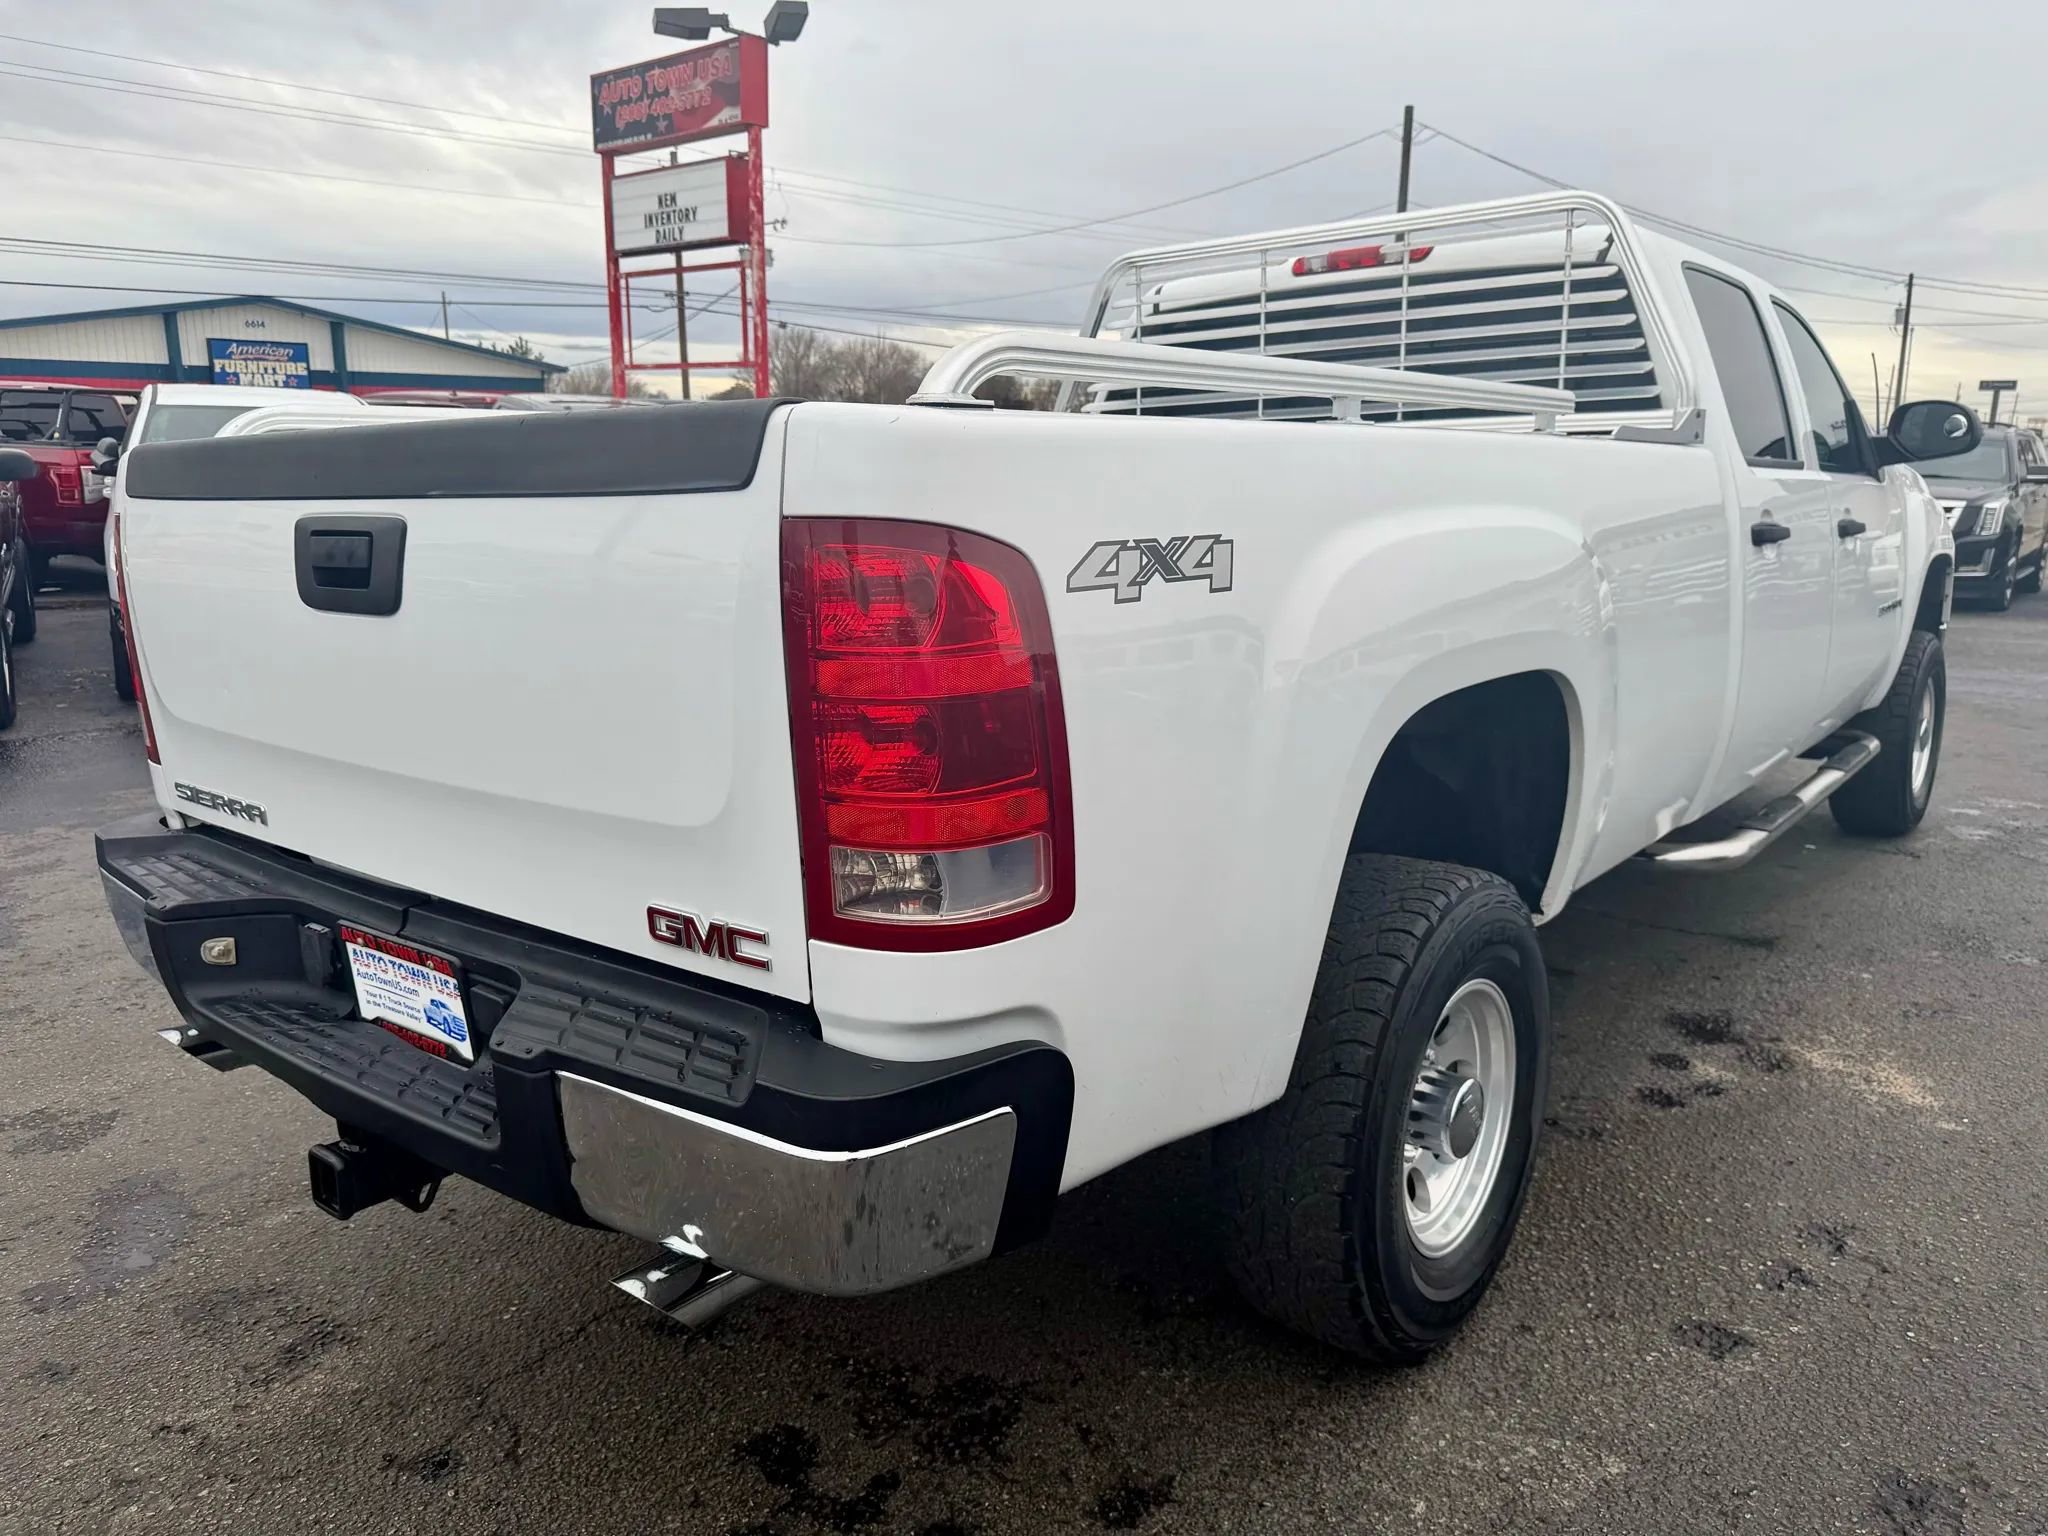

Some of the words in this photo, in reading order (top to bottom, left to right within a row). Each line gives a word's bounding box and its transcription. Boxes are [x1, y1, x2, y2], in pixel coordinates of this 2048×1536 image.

[599, 76, 642, 105] AUTO
[645, 62, 695, 95] TOWN
[698, 54, 733, 80] USA
[644, 206, 698, 229] INVENTORY
[655, 226, 684, 244] DAILY
[245, 320, 265, 329] 6614
[226, 342, 294, 357] American
[213, 359, 308, 376] FURNITURE
[239, 373, 287, 387] MART
[174, 781, 268, 827] SIERRA
[646, 903, 773, 973] GMC
[341, 926, 378, 950] AUTO
[379, 939, 421, 964] TOWN
[421, 952, 455, 977] USA
[352, 948, 389, 974] AUTO
[387, 958, 433, 991] TOWN
